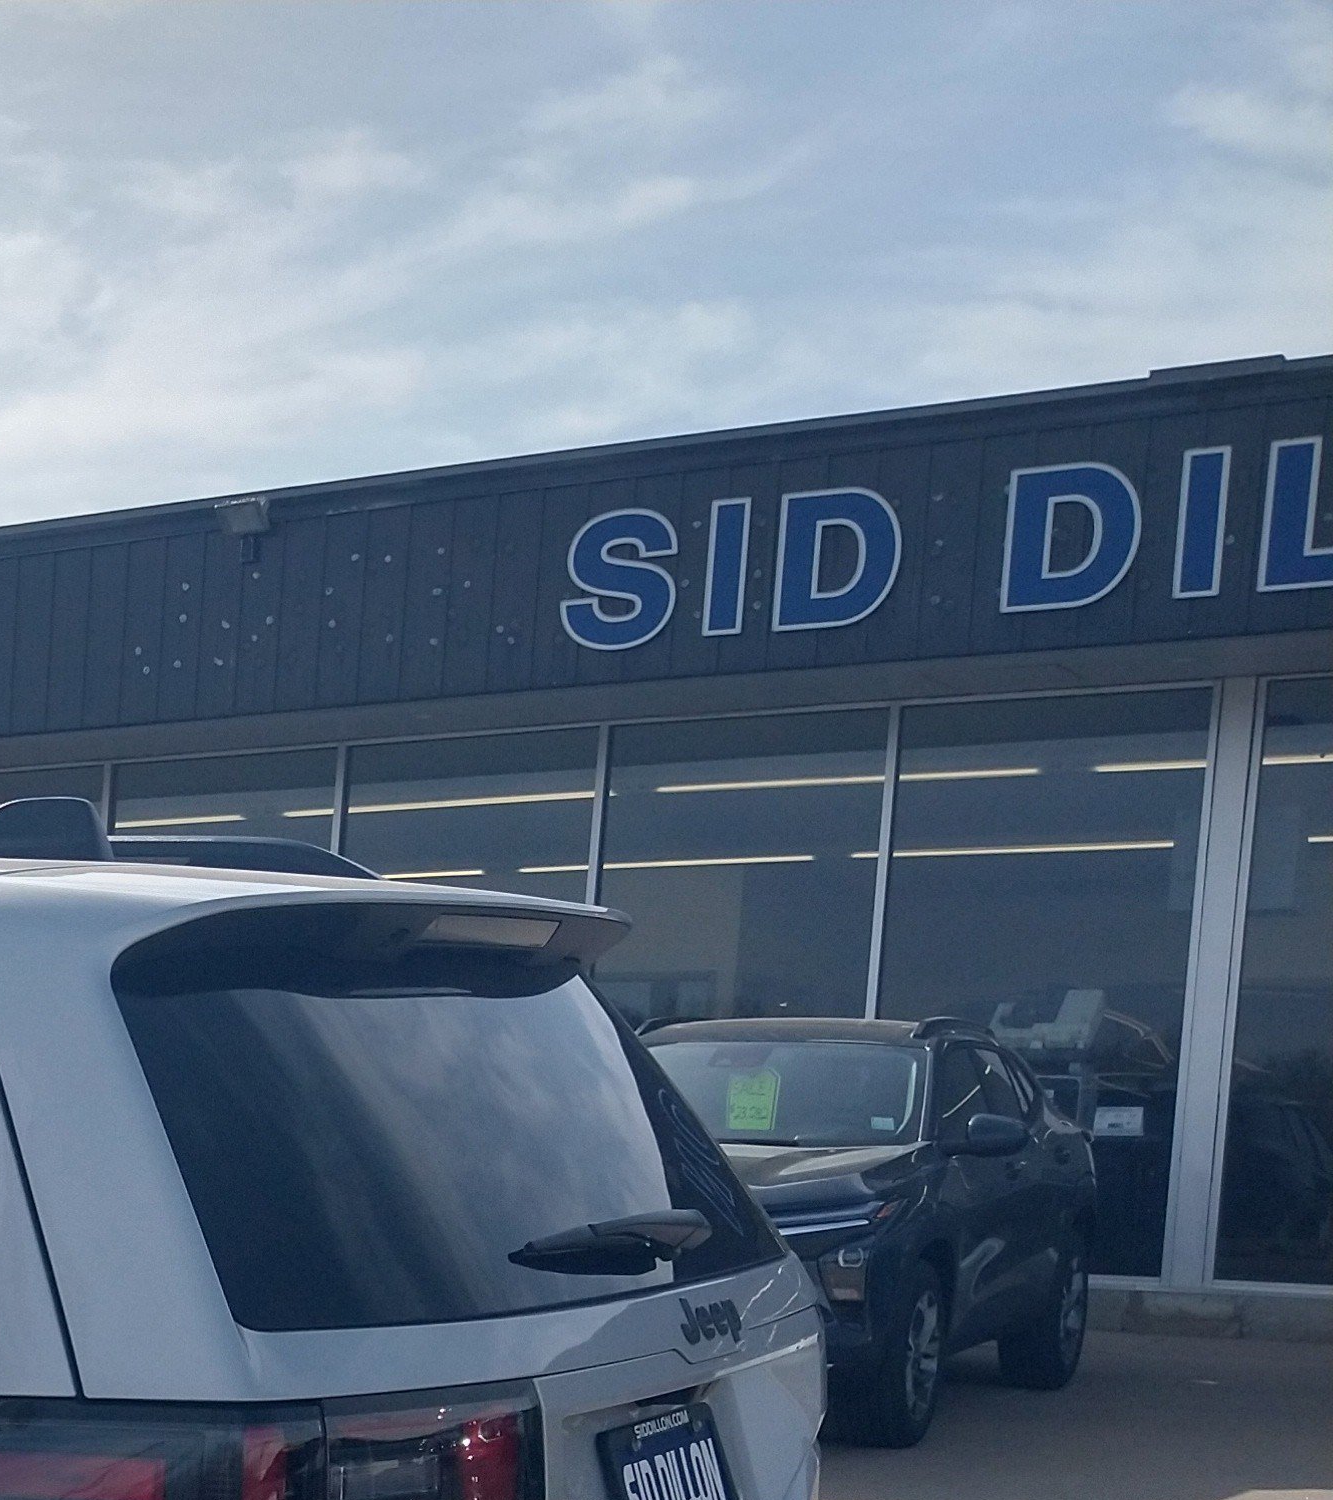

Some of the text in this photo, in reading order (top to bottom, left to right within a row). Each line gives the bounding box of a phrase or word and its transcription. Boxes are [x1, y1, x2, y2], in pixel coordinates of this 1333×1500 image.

[559, 486, 902, 650] SID
[679, 1297, 742, 1346] Jeep
[634, 1409, 690, 1439] SIDDILLON.COM
